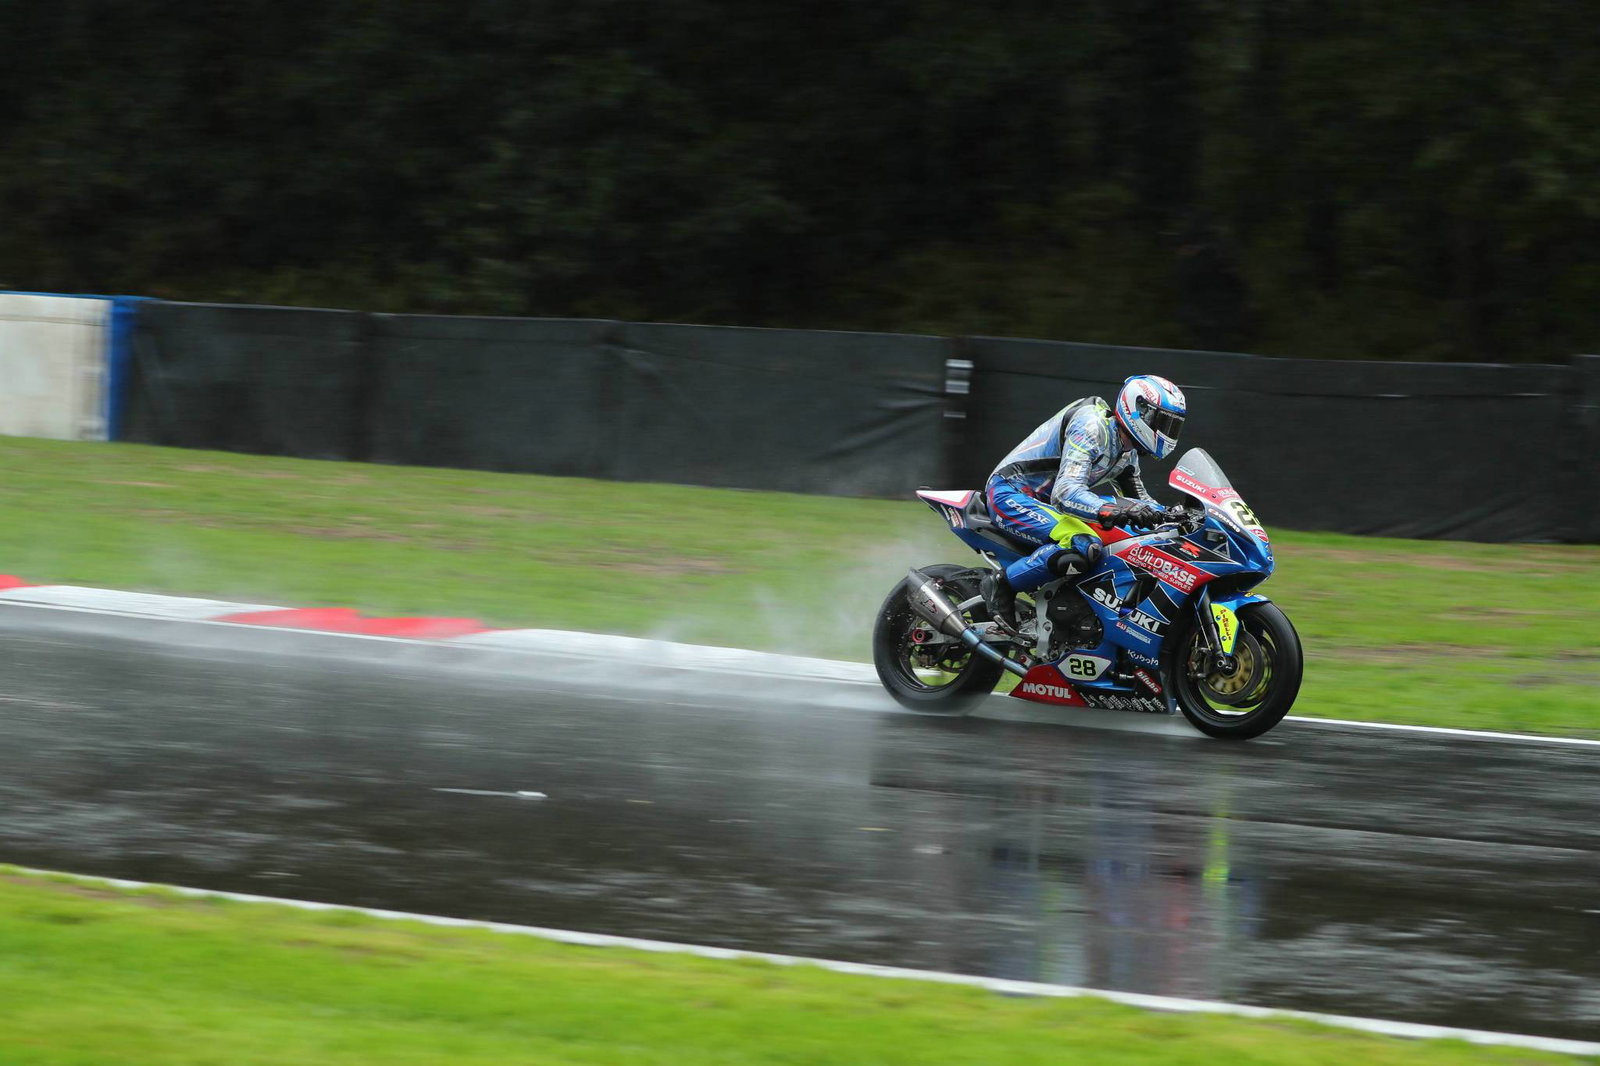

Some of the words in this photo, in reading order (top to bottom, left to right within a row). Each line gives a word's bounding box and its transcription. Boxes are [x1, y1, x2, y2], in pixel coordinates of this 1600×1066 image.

[1175, 475, 1206, 494] SUZUKI
[1004, 498, 1051, 525] DAINESE
[1063, 500, 1098, 516] SUZUK
[1126, 554, 1147, 569] BUILDING
[1169, 577, 1192, 592] SUPPLIES
[1219, 608, 1232, 641] PIRELLI
[1069, 658, 1097, 677] 28
[1127, 649, 1160, 667] Kubota
[1022, 682, 1072, 699] MOTUL
